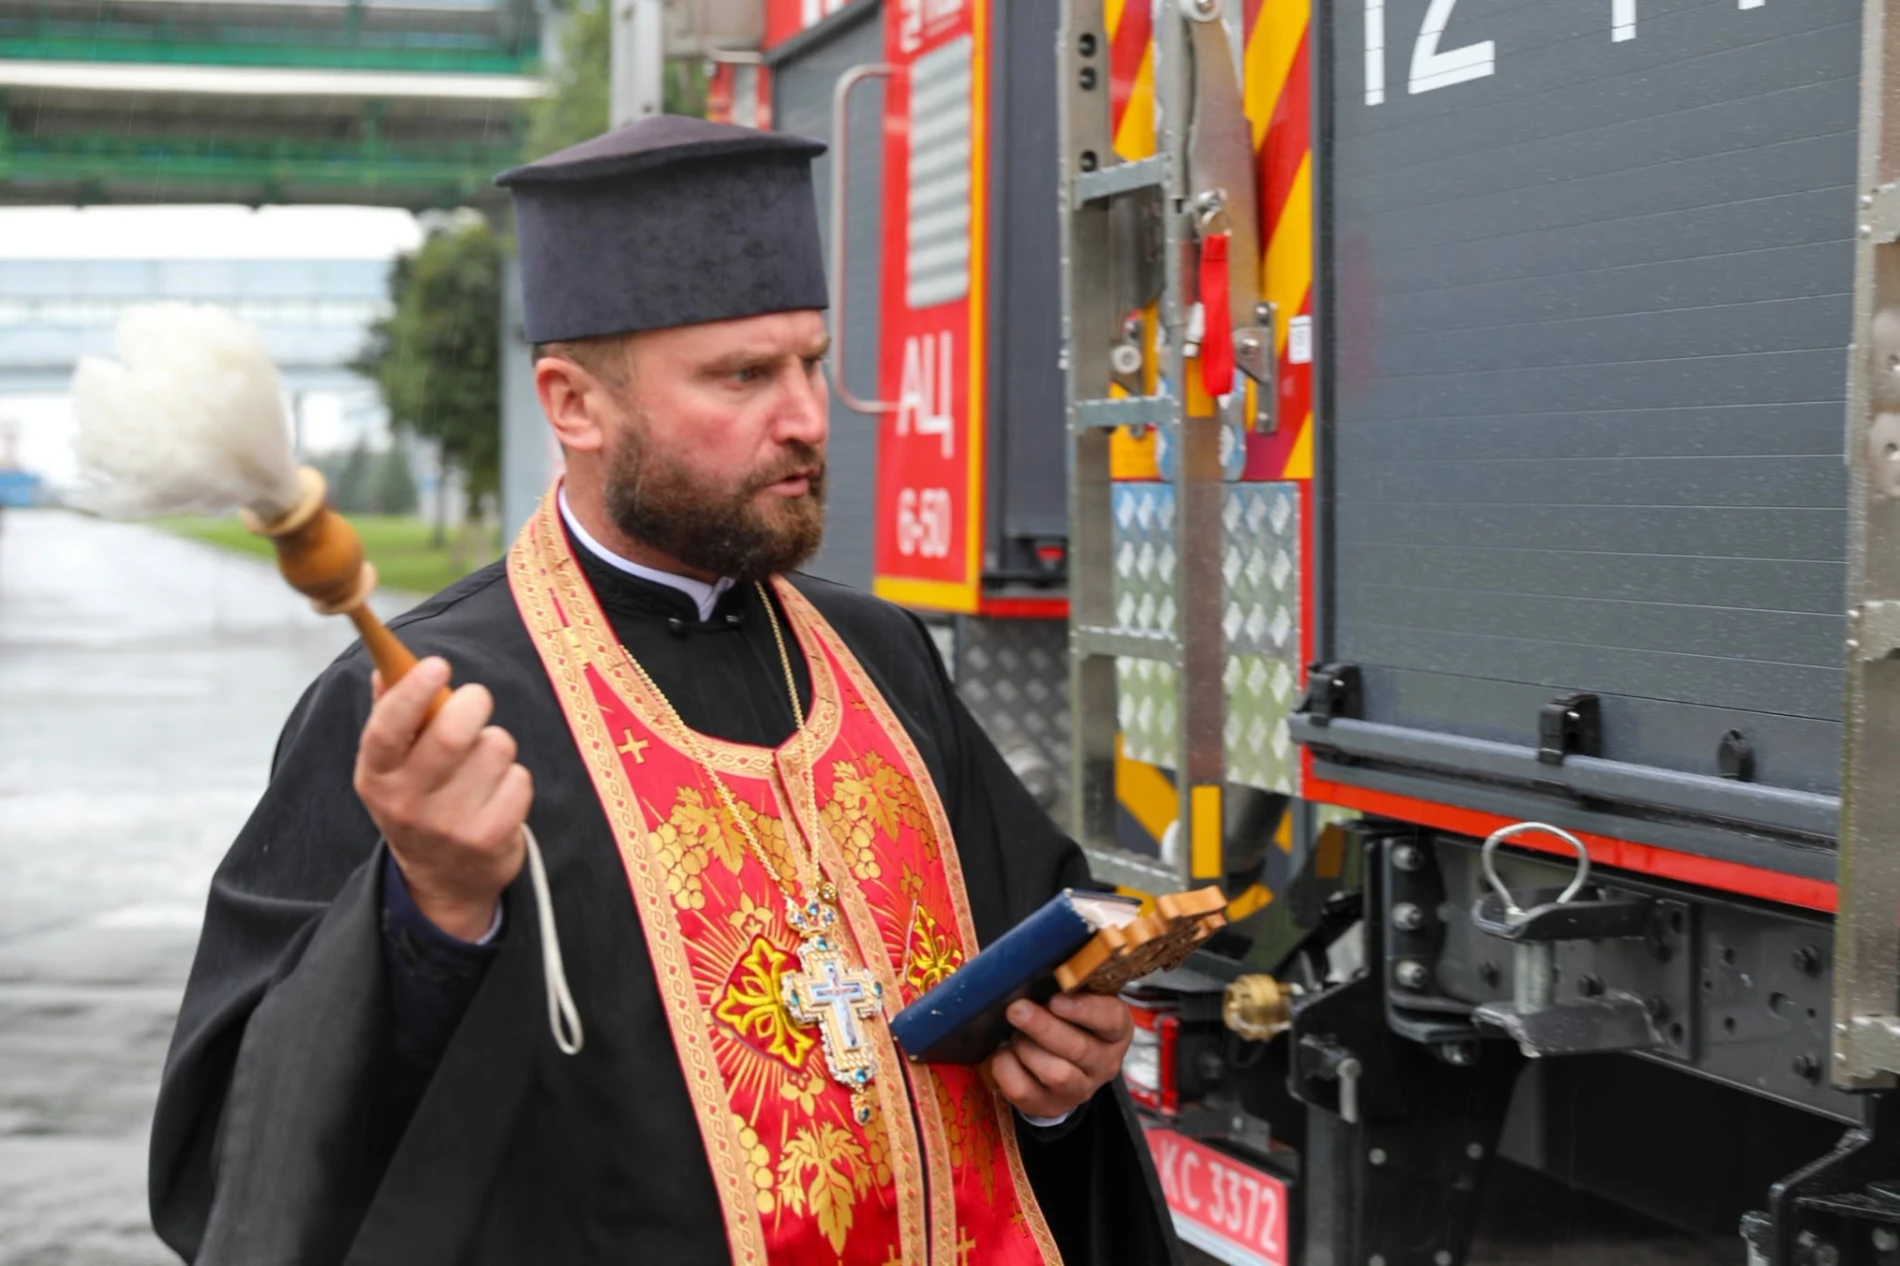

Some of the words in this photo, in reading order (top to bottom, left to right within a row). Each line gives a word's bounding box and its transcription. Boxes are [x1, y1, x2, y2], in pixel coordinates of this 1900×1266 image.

[896, 330, 954, 459] АЦ
[897, 487, 952, 558] 6-50
[1208, 1160, 1279, 1254] 3372
